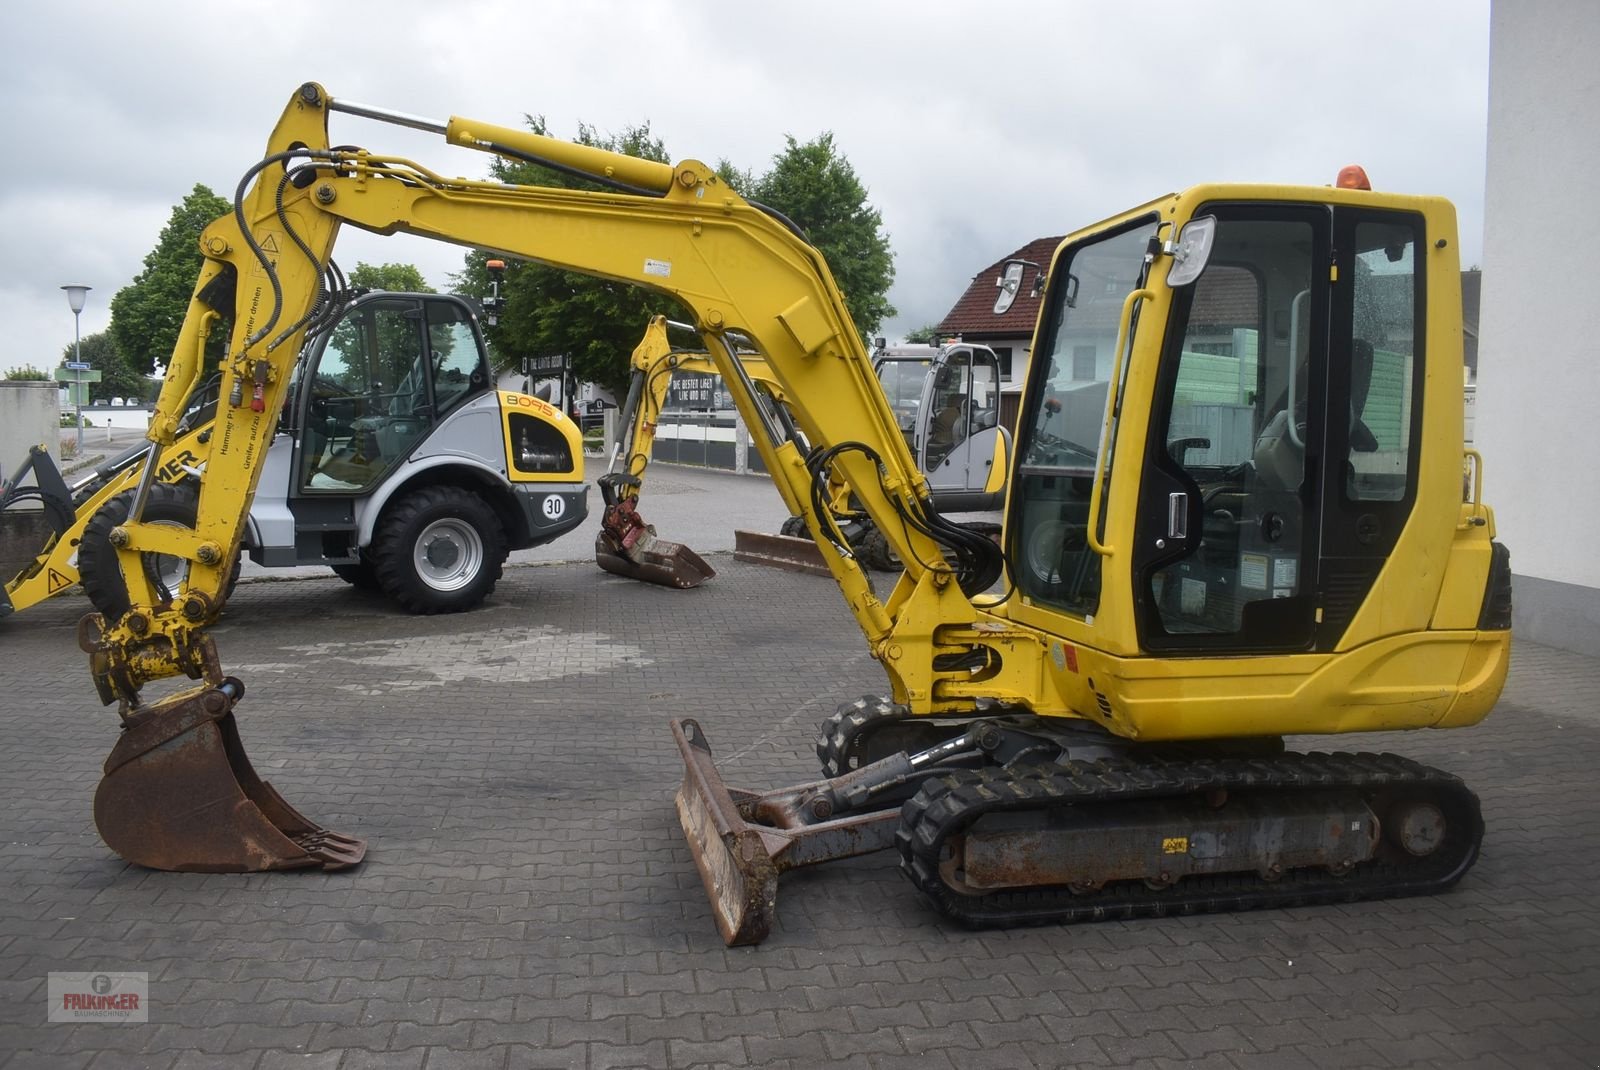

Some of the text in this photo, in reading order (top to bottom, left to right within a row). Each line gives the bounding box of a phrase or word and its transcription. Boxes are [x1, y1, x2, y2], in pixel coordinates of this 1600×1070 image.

[251, 286, 262, 315] drehen
[682, 378, 699, 389] BESTEN
[507, 395, 553, 417] 8095
[220, 420, 234, 456] Hammer
[243, 415, 260, 469] Greifer auf/zu
[546, 499, 561, 515] 30
